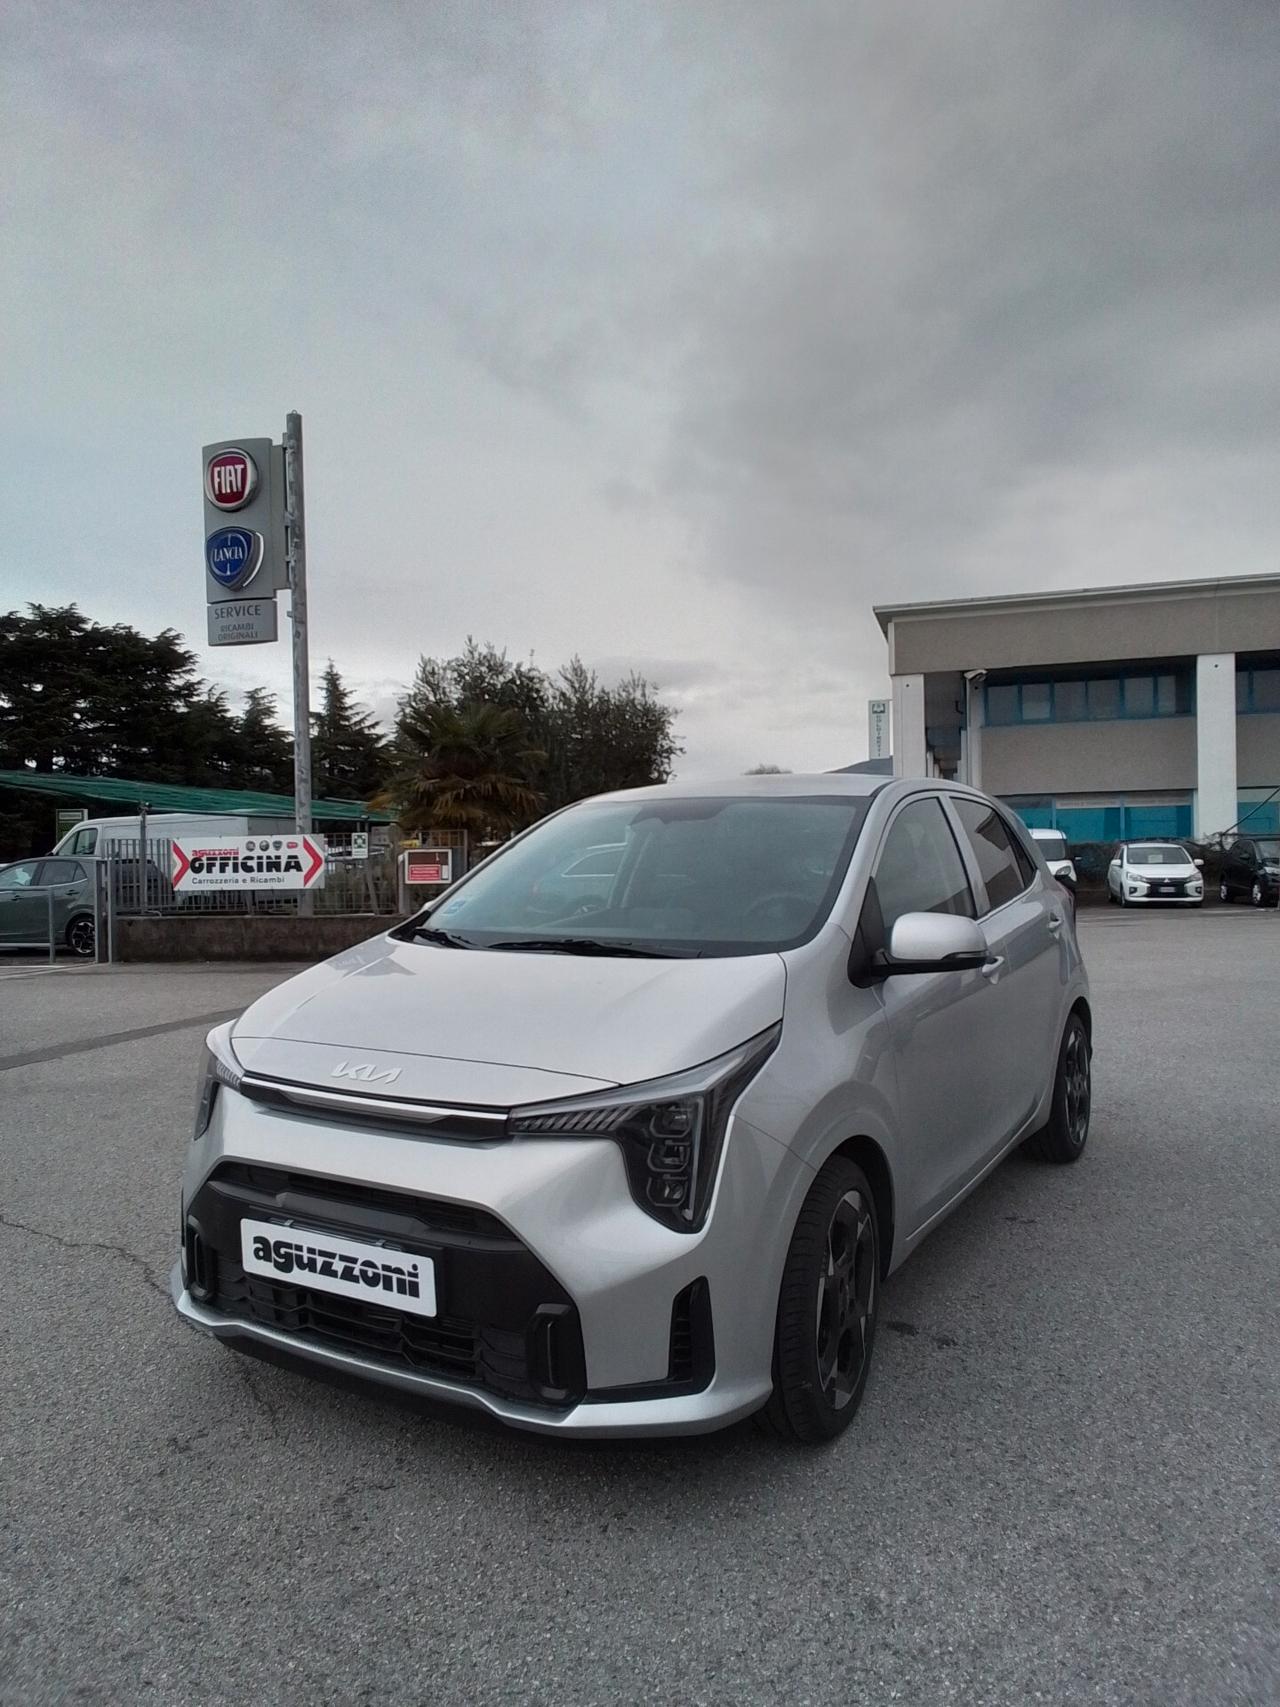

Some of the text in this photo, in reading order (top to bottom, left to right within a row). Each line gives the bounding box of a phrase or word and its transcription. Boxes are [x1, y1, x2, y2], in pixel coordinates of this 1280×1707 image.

[213, 464, 245, 495] FIAT
[214, 546, 243, 562] LANCIA
[214, 605, 262, 620] SERVICE
[220, 622, 254, 633] RICAMBI
[189, 855, 303, 874] OFFICINA
[191, 876, 239, 885] Carrozzeria
[250, 876, 285, 884] Ricambi
[252, 1235, 421, 1299] aguzzoni
